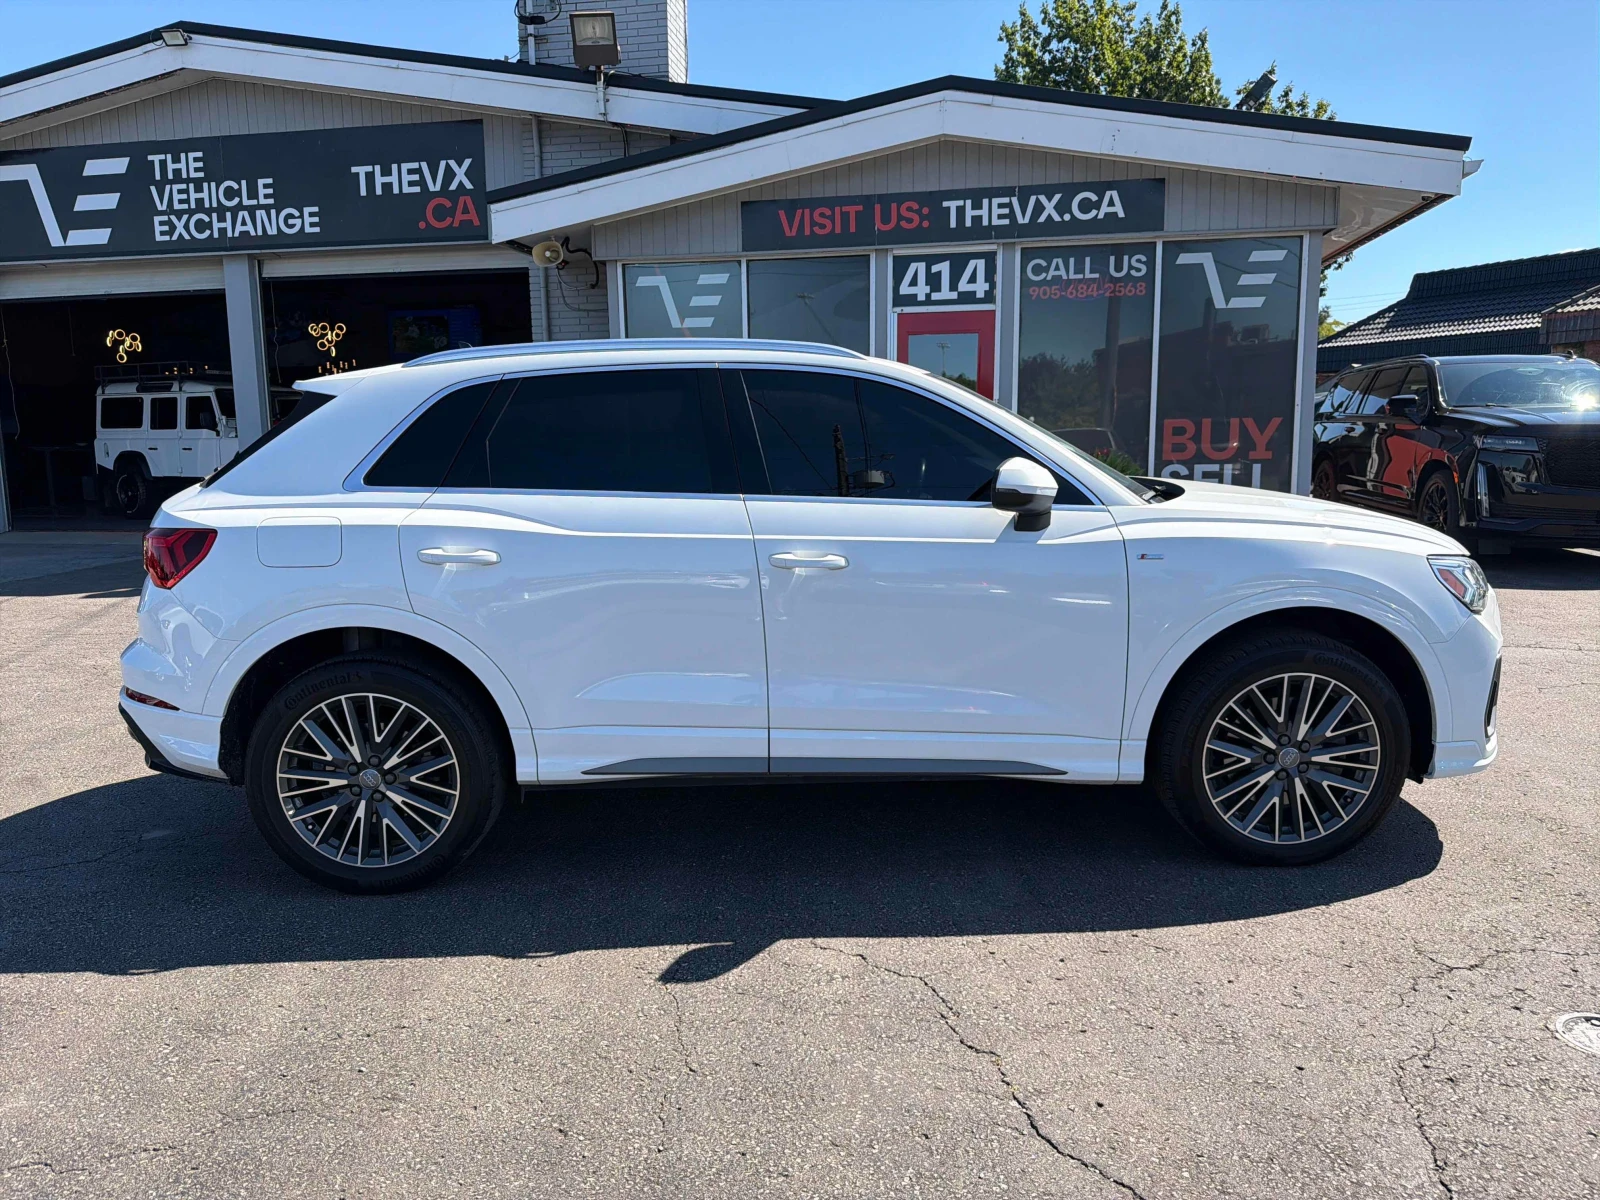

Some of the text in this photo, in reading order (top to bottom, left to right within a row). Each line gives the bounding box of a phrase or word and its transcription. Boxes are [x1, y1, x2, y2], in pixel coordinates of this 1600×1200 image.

[147, 152, 205, 180] THE
[350, 158, 474, 197] THEVX
[150, 178, 275, 212] VEHICLE
[418, 195, 480, 230] .CA
[153, 206, 321, 242] EXCHANGE
[778, 190, 1126, 237] VISIT US: THEVX.CA
[899, 259, 989, 302] 414
[1026, 254, 1148, 281] CALL US
[1029, 282, 1147, 300] 905-684-2568
[1162, 417, 1283, 461] BUY
[284, 671, 351, 710] Continental
